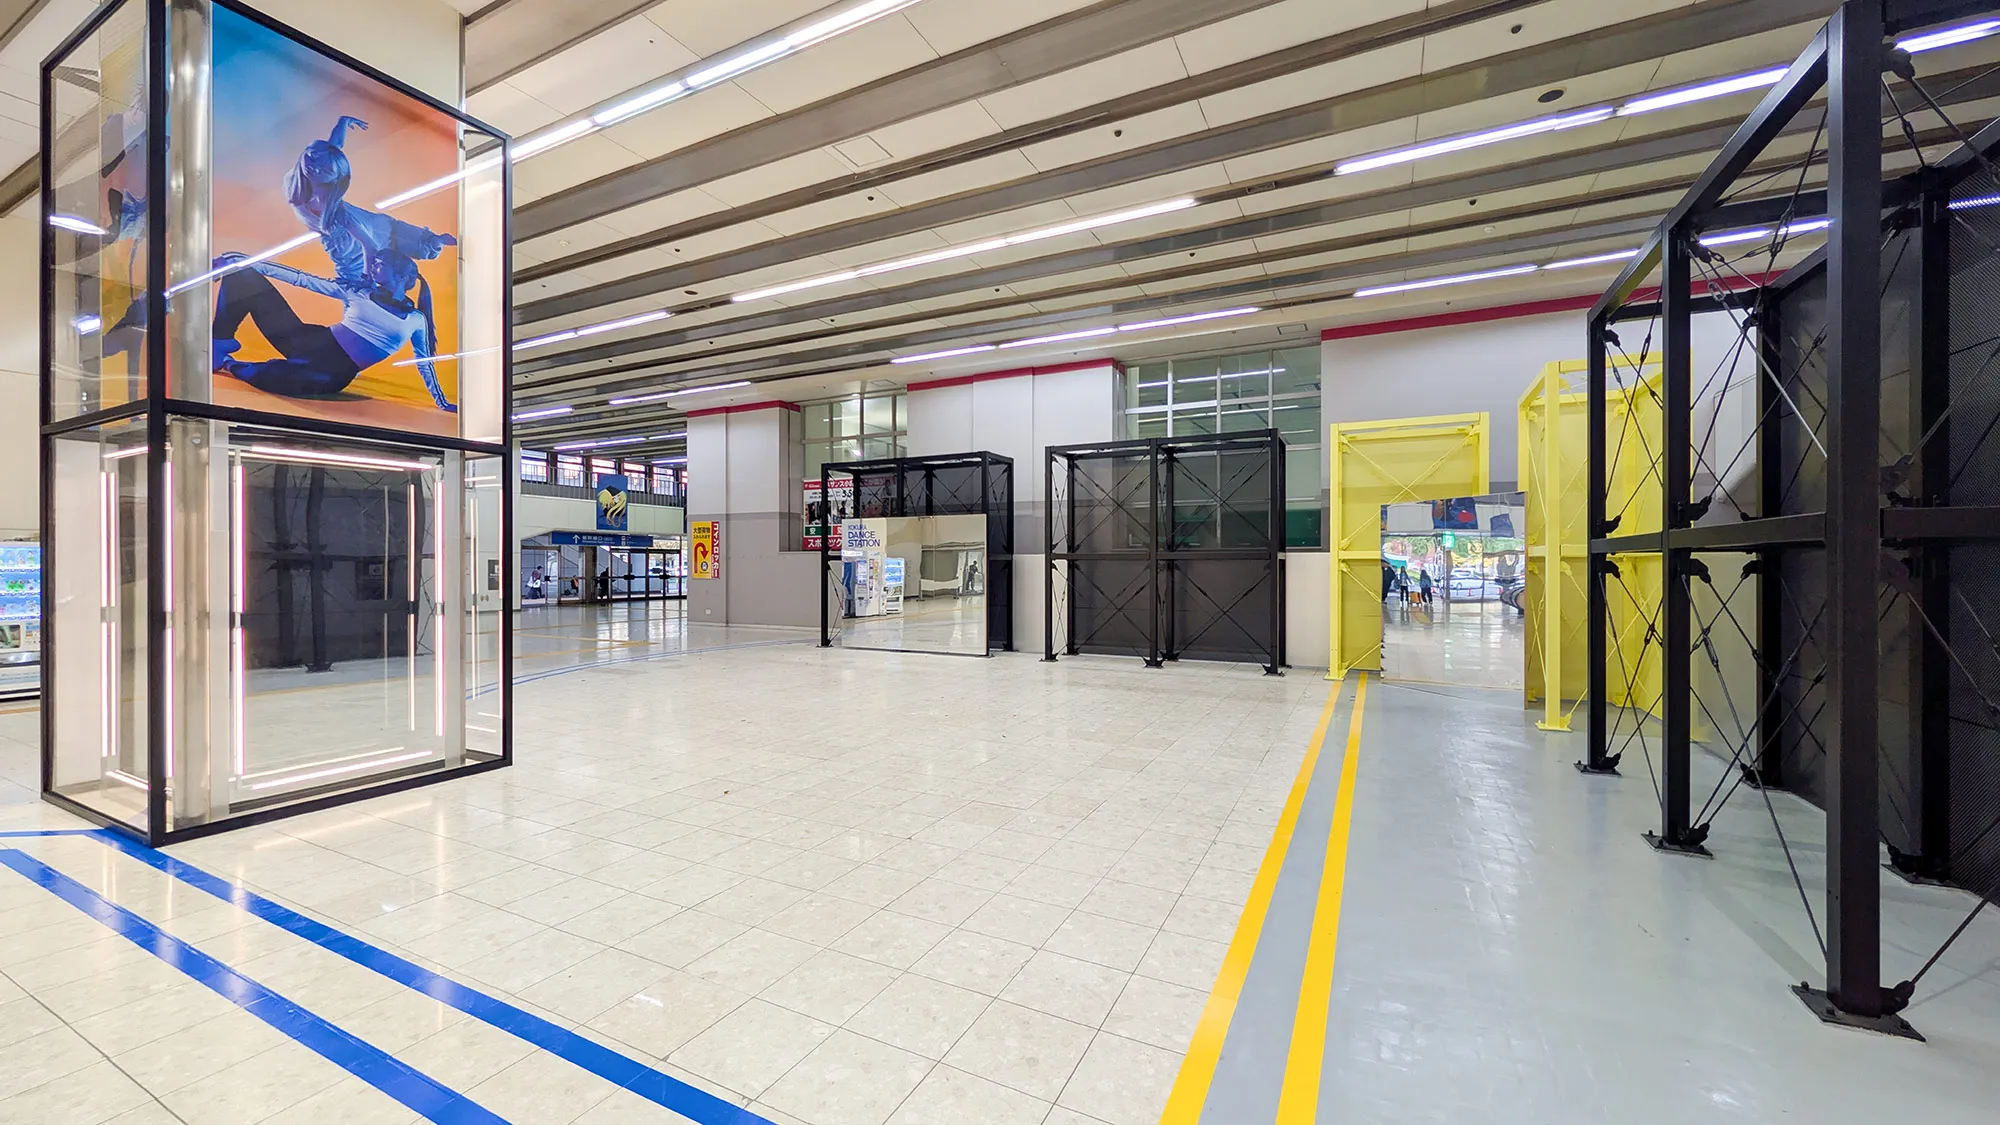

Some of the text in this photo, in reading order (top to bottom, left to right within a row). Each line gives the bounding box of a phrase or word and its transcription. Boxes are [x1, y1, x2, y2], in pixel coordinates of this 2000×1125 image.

[808, 538, 842, 548] スポツク
[848, 539, 880, 547] STATION
